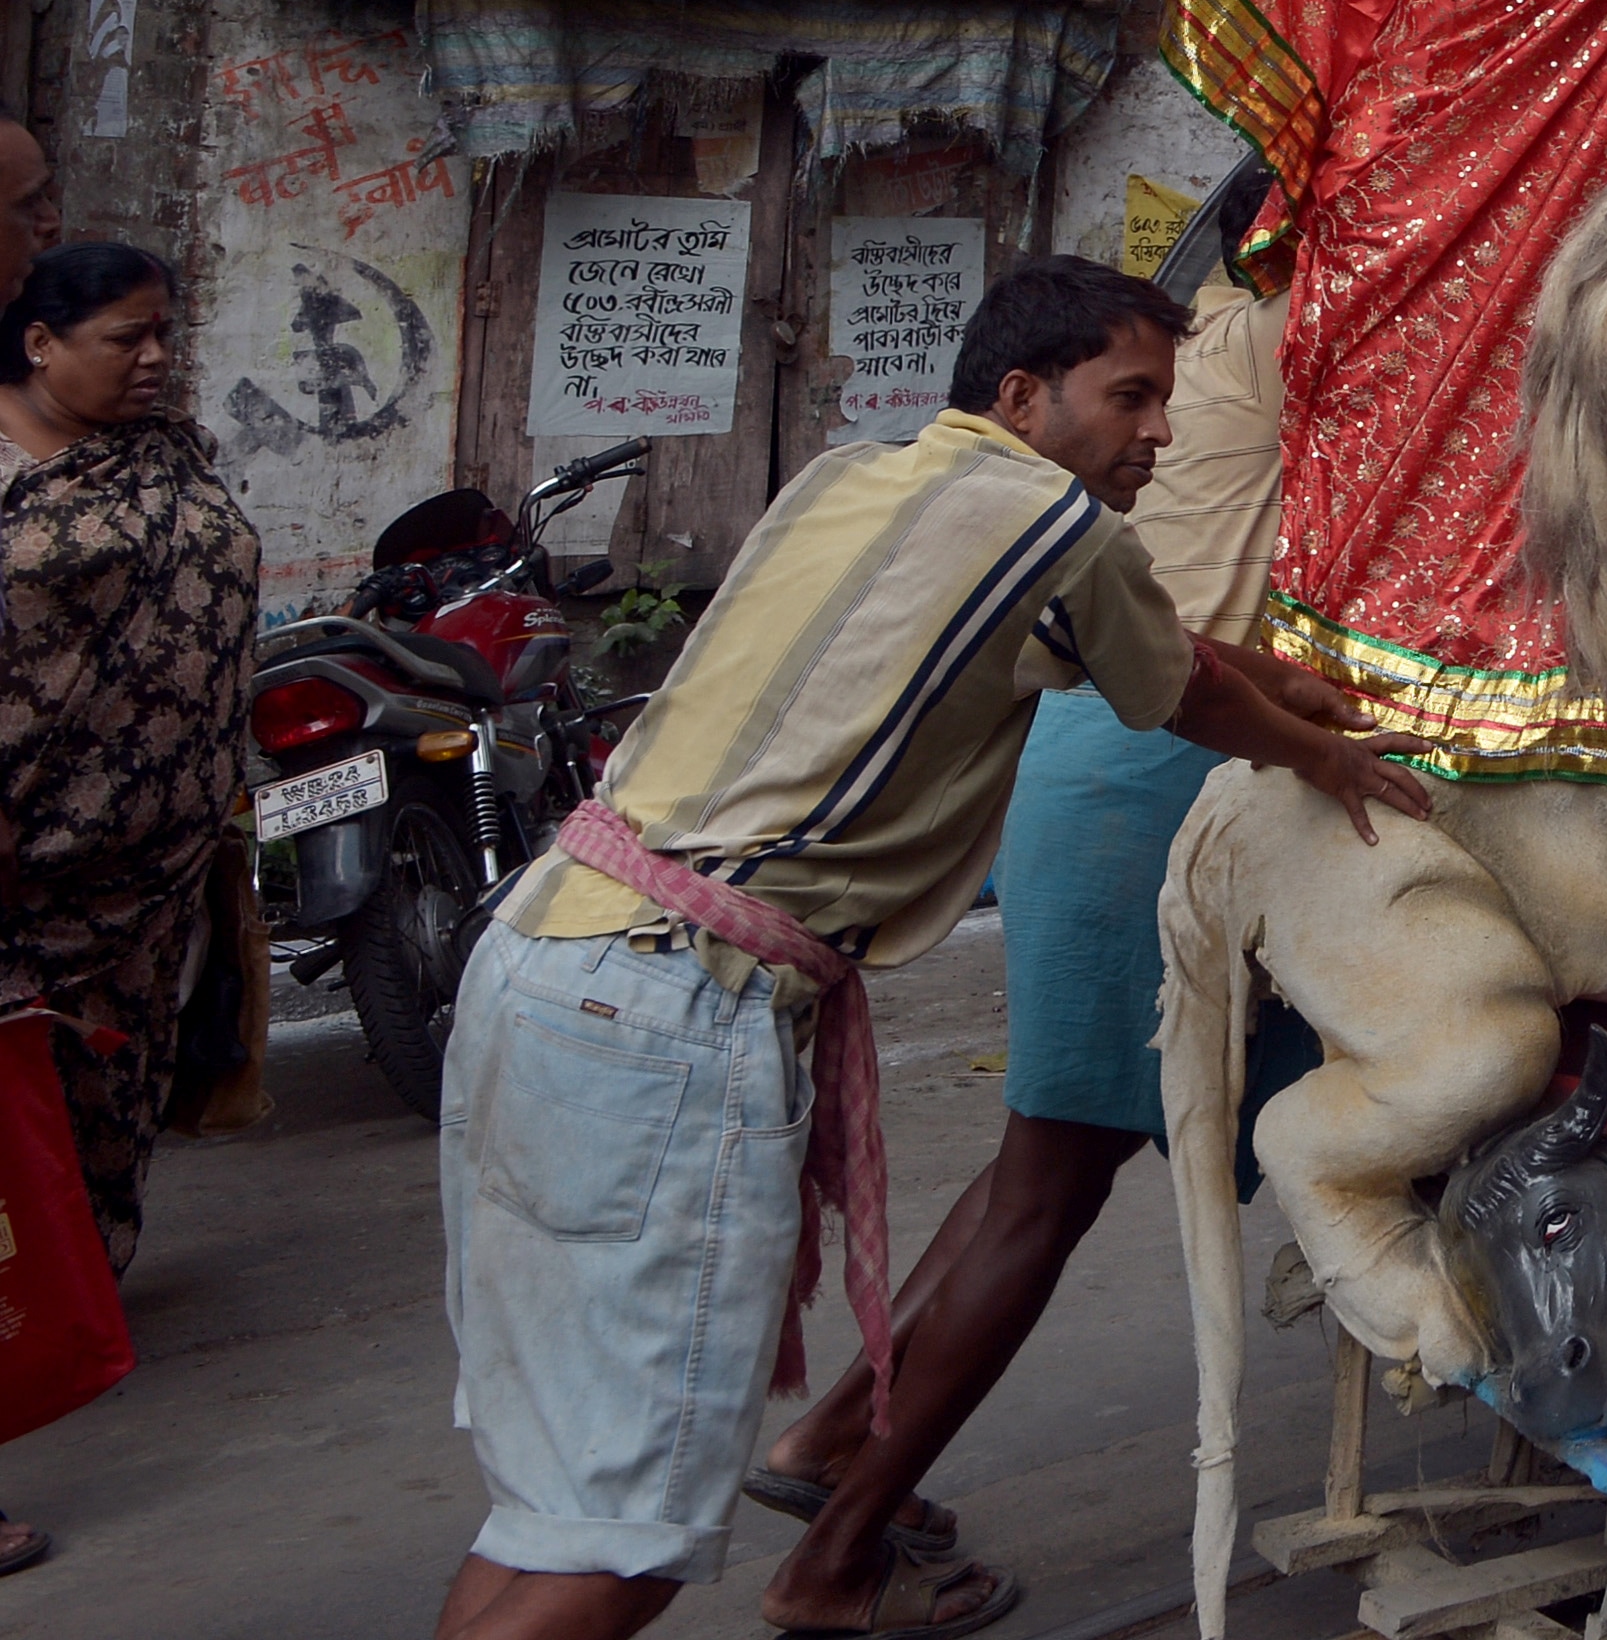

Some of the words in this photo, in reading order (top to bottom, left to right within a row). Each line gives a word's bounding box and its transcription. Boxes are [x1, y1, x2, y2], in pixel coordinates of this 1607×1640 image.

[677, 219, 732, 257] তুমি
[568, 259, 640, 286] জেনে
[646, 262, 706, 285] রেখো
[862, 269, 920, 298] উচ্ছেদ
[921, 271, 962, 295] করে
[559, 343, 624, 372] উচ্ছেদ
